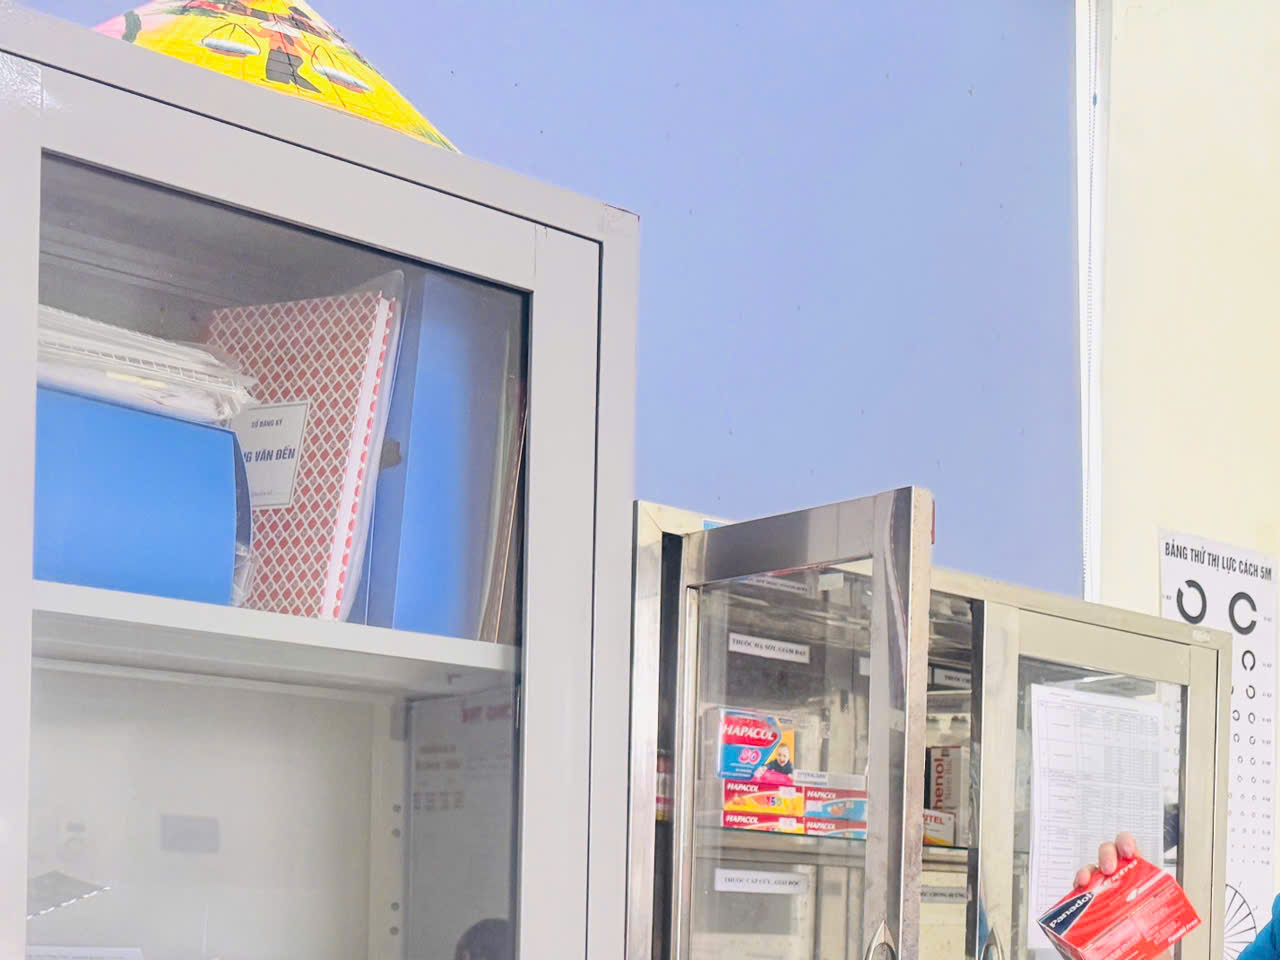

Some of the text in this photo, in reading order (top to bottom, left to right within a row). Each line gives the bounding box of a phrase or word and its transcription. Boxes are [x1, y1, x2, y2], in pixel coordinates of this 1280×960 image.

[254, 448, 274, 462] VĂN
[275, 445, 296, 460] ĐẾN
[1164, 539, 1272, 581] BẢNG THỬ THỊ LỰC CÁCH 5M
[722, 724, 776, 741] HAPACOL
[738, 748, 761, 764] 80
[726, 782, 760, 793] HAPACOL
[933, 758, 945, 810] henol
[806, 790, 836, 799] HAPACOL
[725, 814, 759, 824] HAPACOL
[806, 821, 836, 830] HAPACOL
[1049, 891, 1094, 928] Panadol
